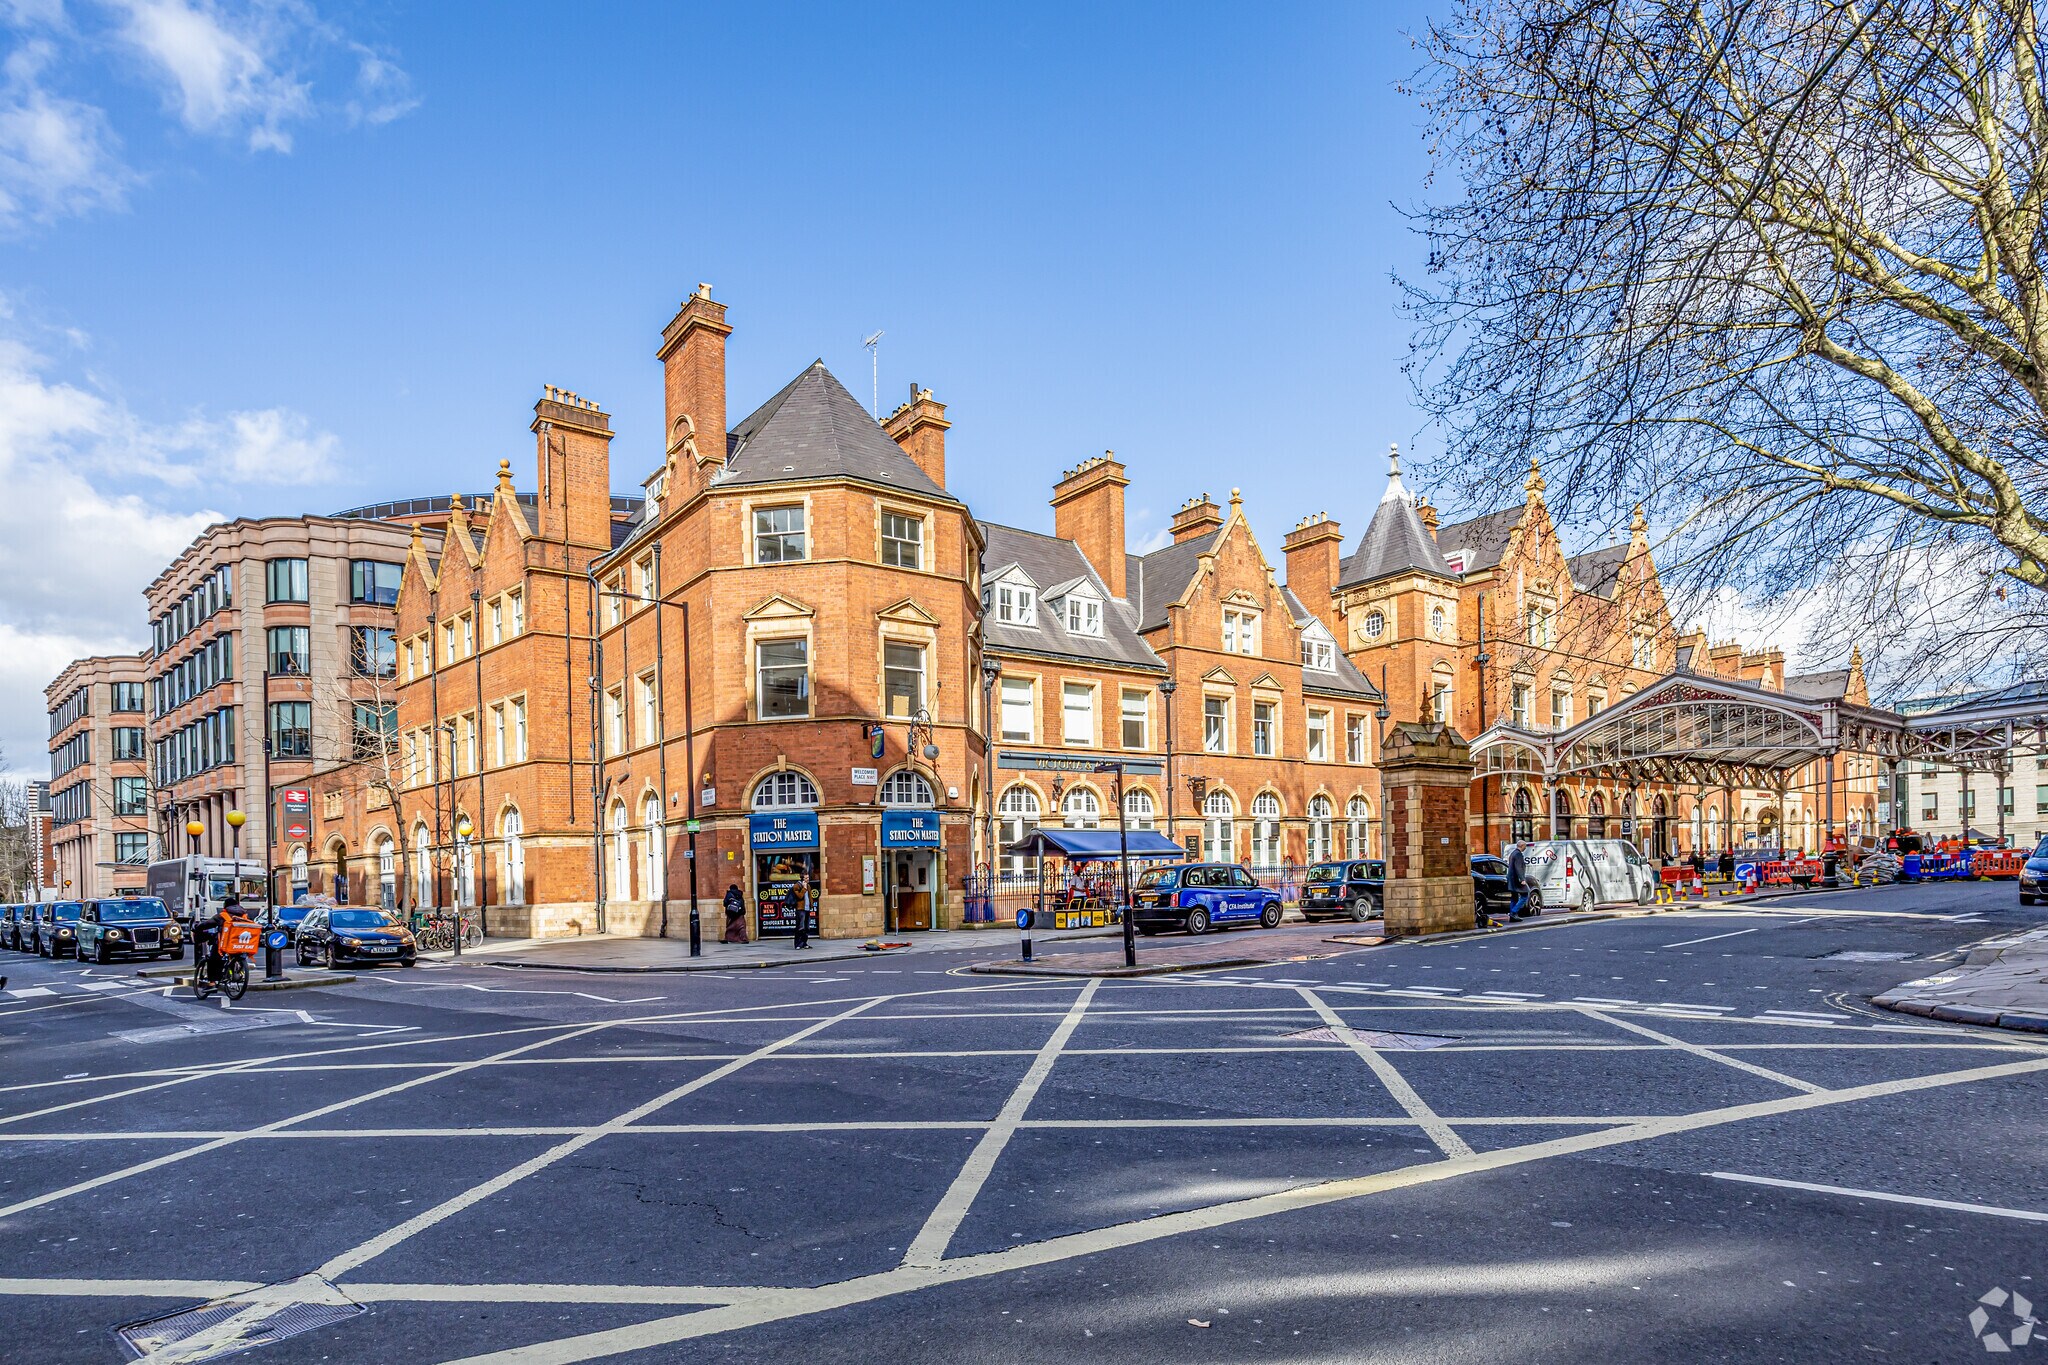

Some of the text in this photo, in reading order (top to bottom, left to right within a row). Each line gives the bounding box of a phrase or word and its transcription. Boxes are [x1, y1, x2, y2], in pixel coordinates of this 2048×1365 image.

[1036, 759, 1082, 770] VICTORIA
[773, 818, 787, 829] THE
[911, 818, 923, 828] THE
[753, 830, 812, 843] STATION MASTER
[889, 829, 940, 841] STATION MASTER
[1524, 856, 1549, 865] serv
